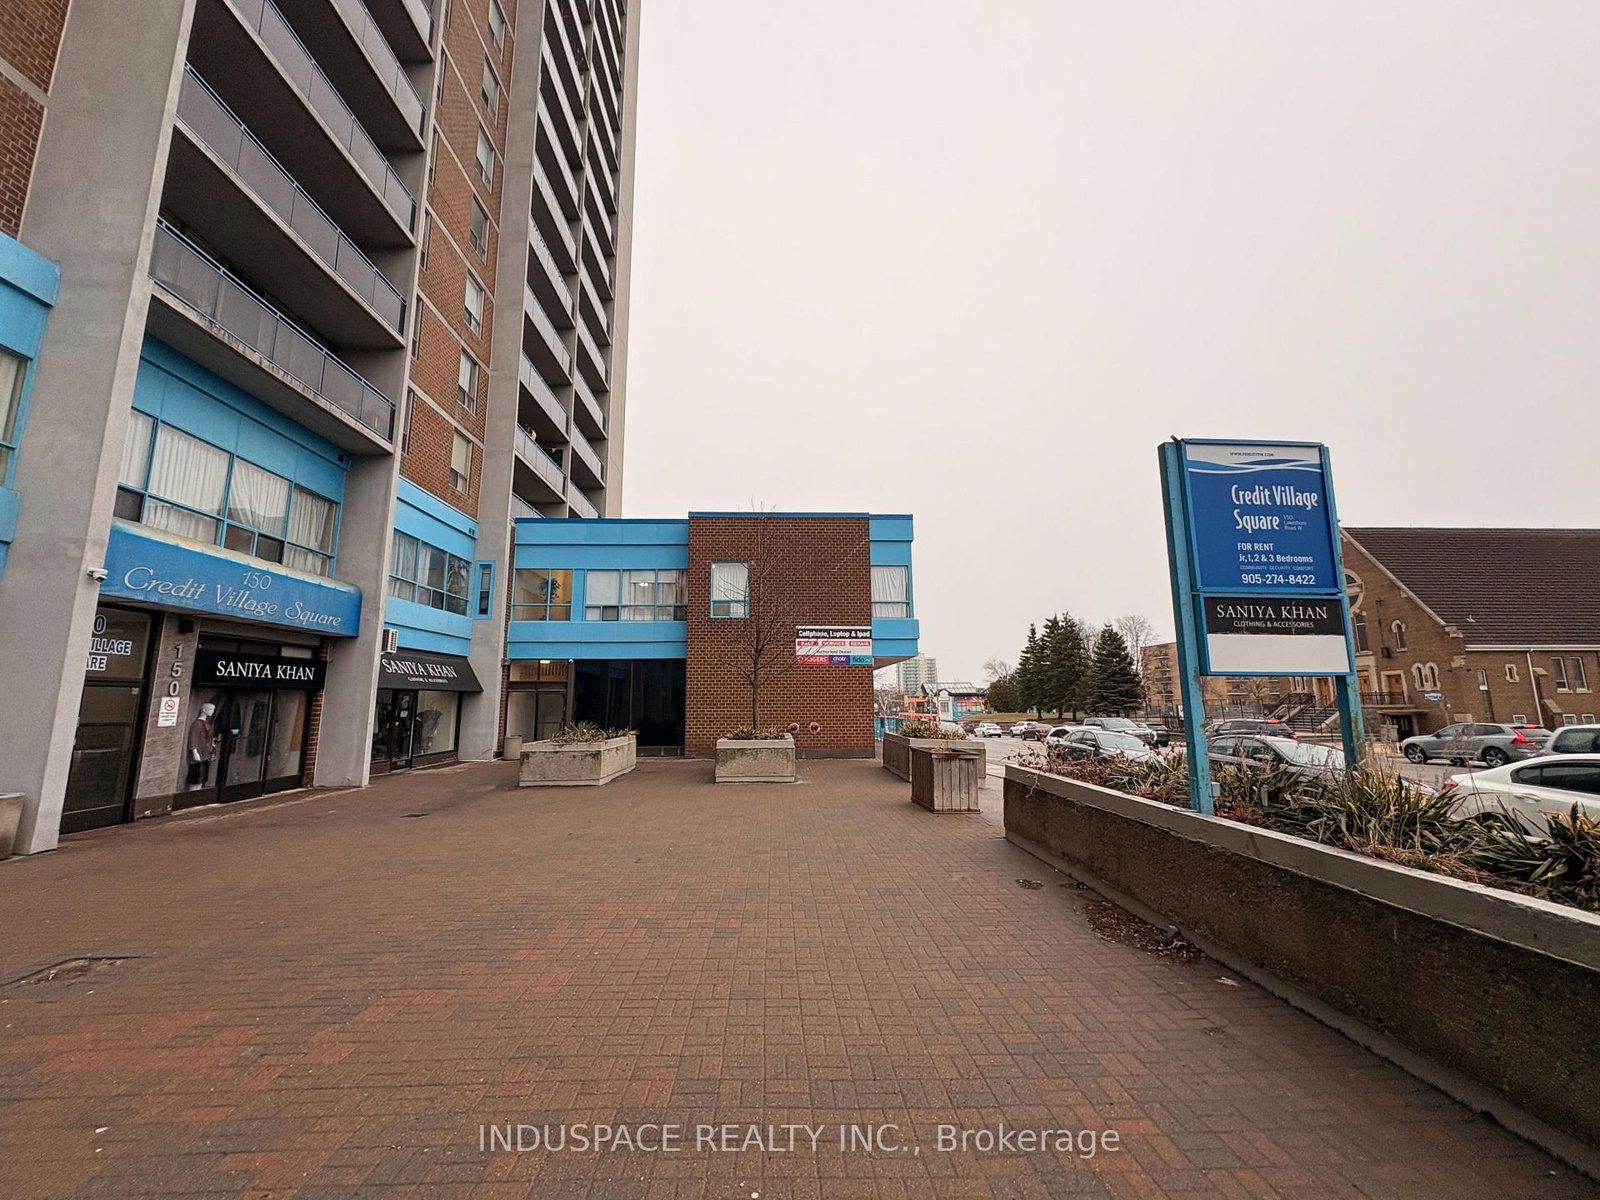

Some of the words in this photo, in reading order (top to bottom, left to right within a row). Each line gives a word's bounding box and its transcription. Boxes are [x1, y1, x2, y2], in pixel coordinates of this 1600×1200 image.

[1231, 484, 1272, 505] Credit
[1272, 485, 1318, 510] Village
[1233, 508, 1280, 534] Square
[1237, 542, 1253, 551] FOR
[1254, 542, 1274, 551] RENT
[1261, 554, 1268, 562] &
[1276, 555, 1314, 563] Bedrooms
[242, 570, 272, 590] 150
[1241, 573, 1316, 585] 905-274-8422
[124, 566, 206, 600] Credit
[215, 584, 278, 616] Village
[284, 600, 342, 626] Square
[1216, 604, 1276, 619] SANIYA
[1281, 605, 1328, 619] KHAN
[1233, 620, 1266, 628] CLOTHING
[1266, 620, 1272, 628] &
[1273, 620, 1315, 628] ACCESSORIES
[90, 638, 132, 655] ILLAGE
[216, 660, 272, 679] SANIYA
[276, 665, 315, 681] KHAN
[381, 659, 427, 676] SANIYA
[426, 664, 457, 678] KHAN
